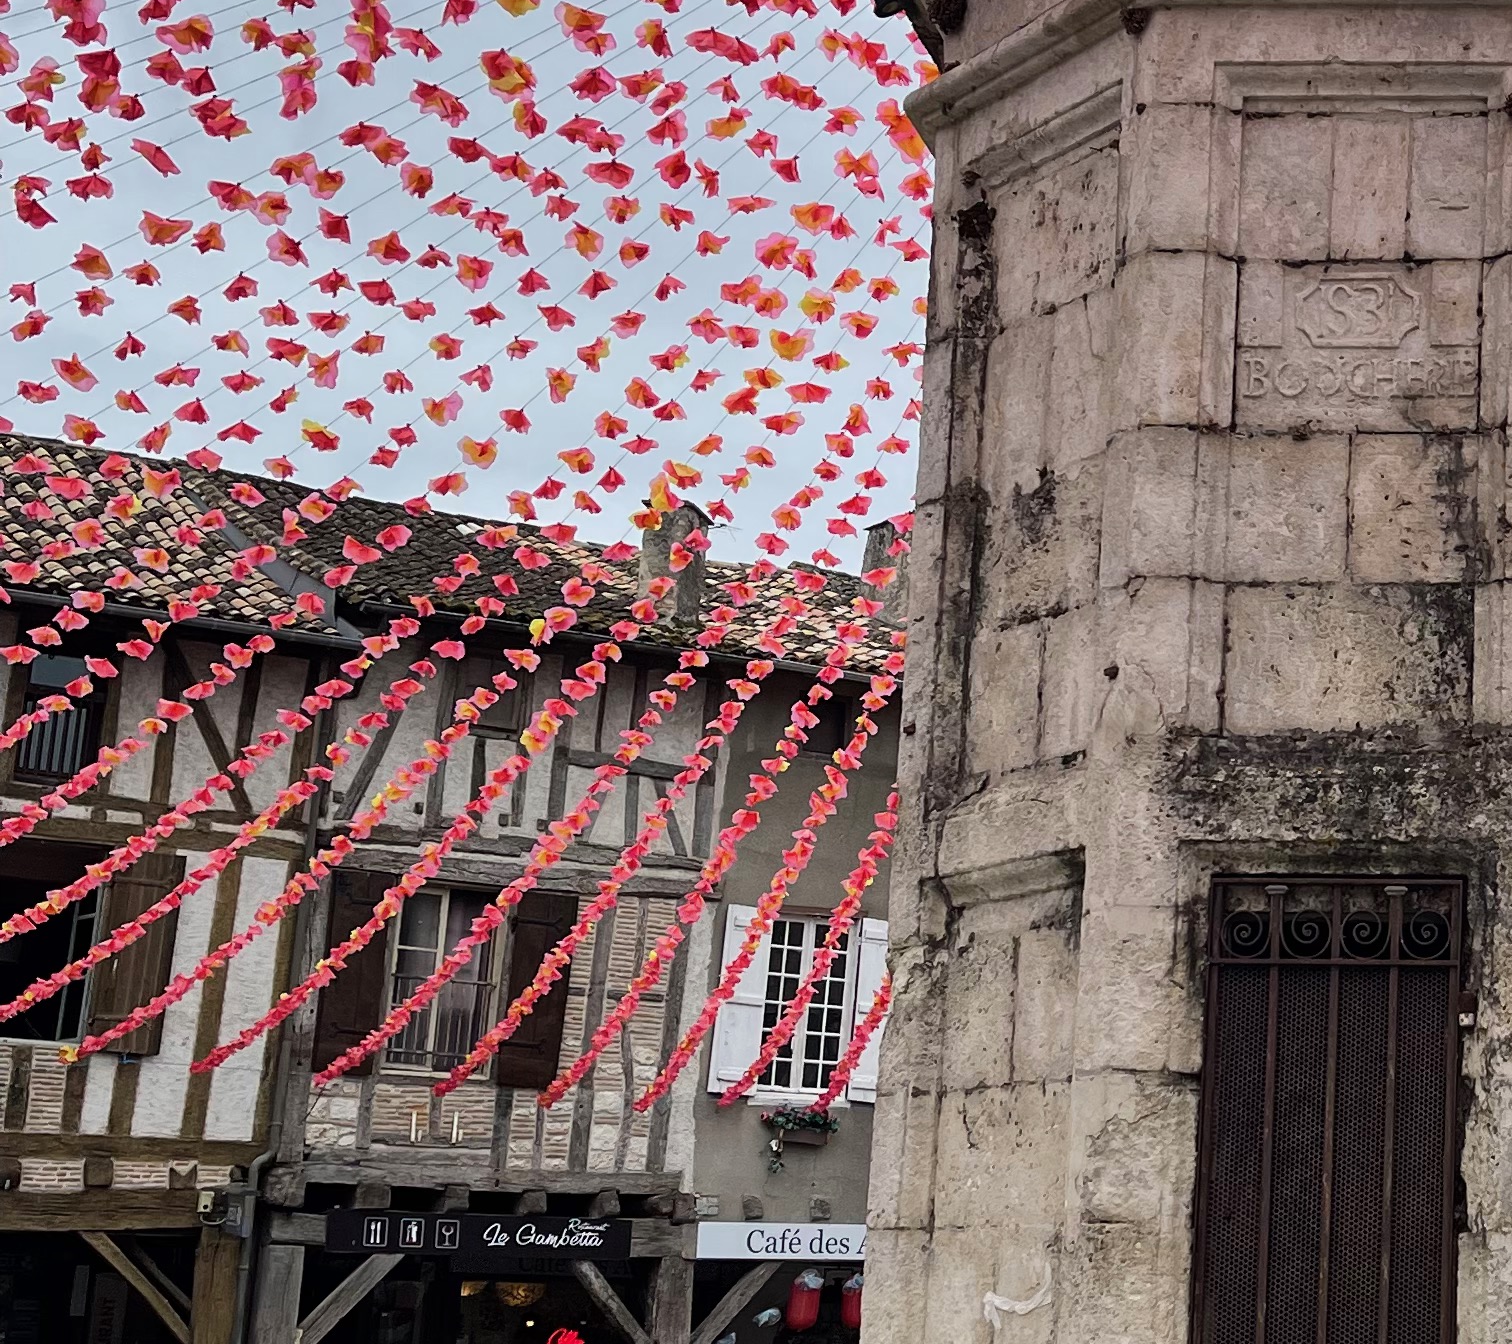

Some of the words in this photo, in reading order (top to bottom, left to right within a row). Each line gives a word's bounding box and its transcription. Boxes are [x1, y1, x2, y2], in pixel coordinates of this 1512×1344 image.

[482, 1223, 510, 1247] Le
[515, 1223, 604, 1248] Gambetta
[746, 1228, 802, 1254] Café
[809, 1228, 850, 1254] des
